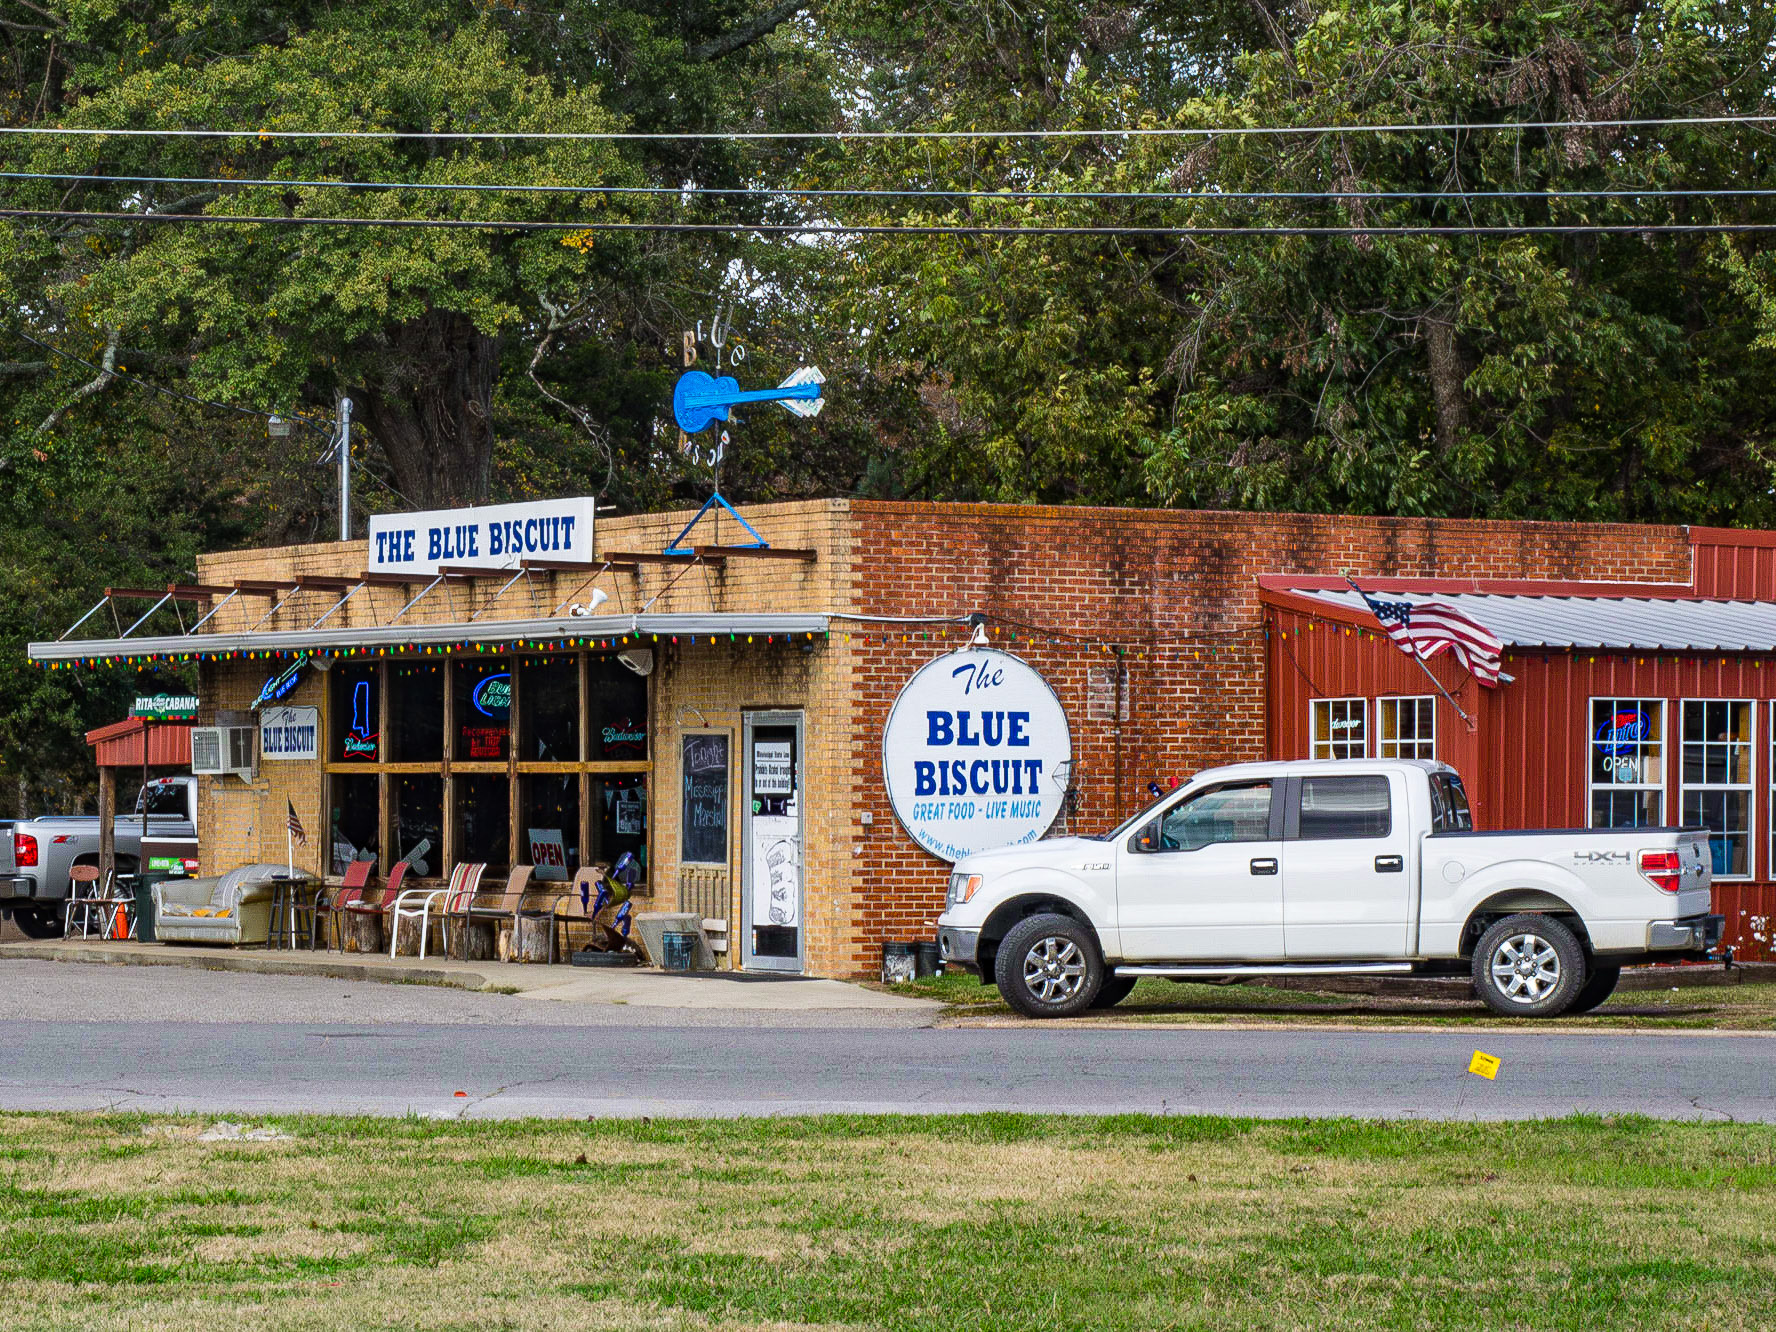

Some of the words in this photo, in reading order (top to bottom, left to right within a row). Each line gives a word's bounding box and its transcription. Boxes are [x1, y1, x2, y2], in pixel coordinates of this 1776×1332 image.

[376, 529, 415, 563] THE
[428, 524, 478, 560] BLUE
[489, 516, 576, 556] BISCUIT
[952, 659, 1004, 695] The
[135, 697, 153, 710] RITA
[165, 696, 196, 710] CABANA
[281, 708, 297, 727] The
[927, 710, 1030, 747] BLUE
[263, 727, 283, 753] BLUE
[284, 725, 315, 752] BISCUIT
[684, 737, 724, 768] Tonight
[914, 760, 1042, 796] BISCUIT
[1603, 756, 1638, 772] OPEN
[913, 801, 945, 821] GREAT
[948, 801, 975, 820] FOOD
[986, 801, 1007, 819] LIVE
[1009, 800, 1041, 819] MUSIC
[532, 842, 565, 866] OPEN
